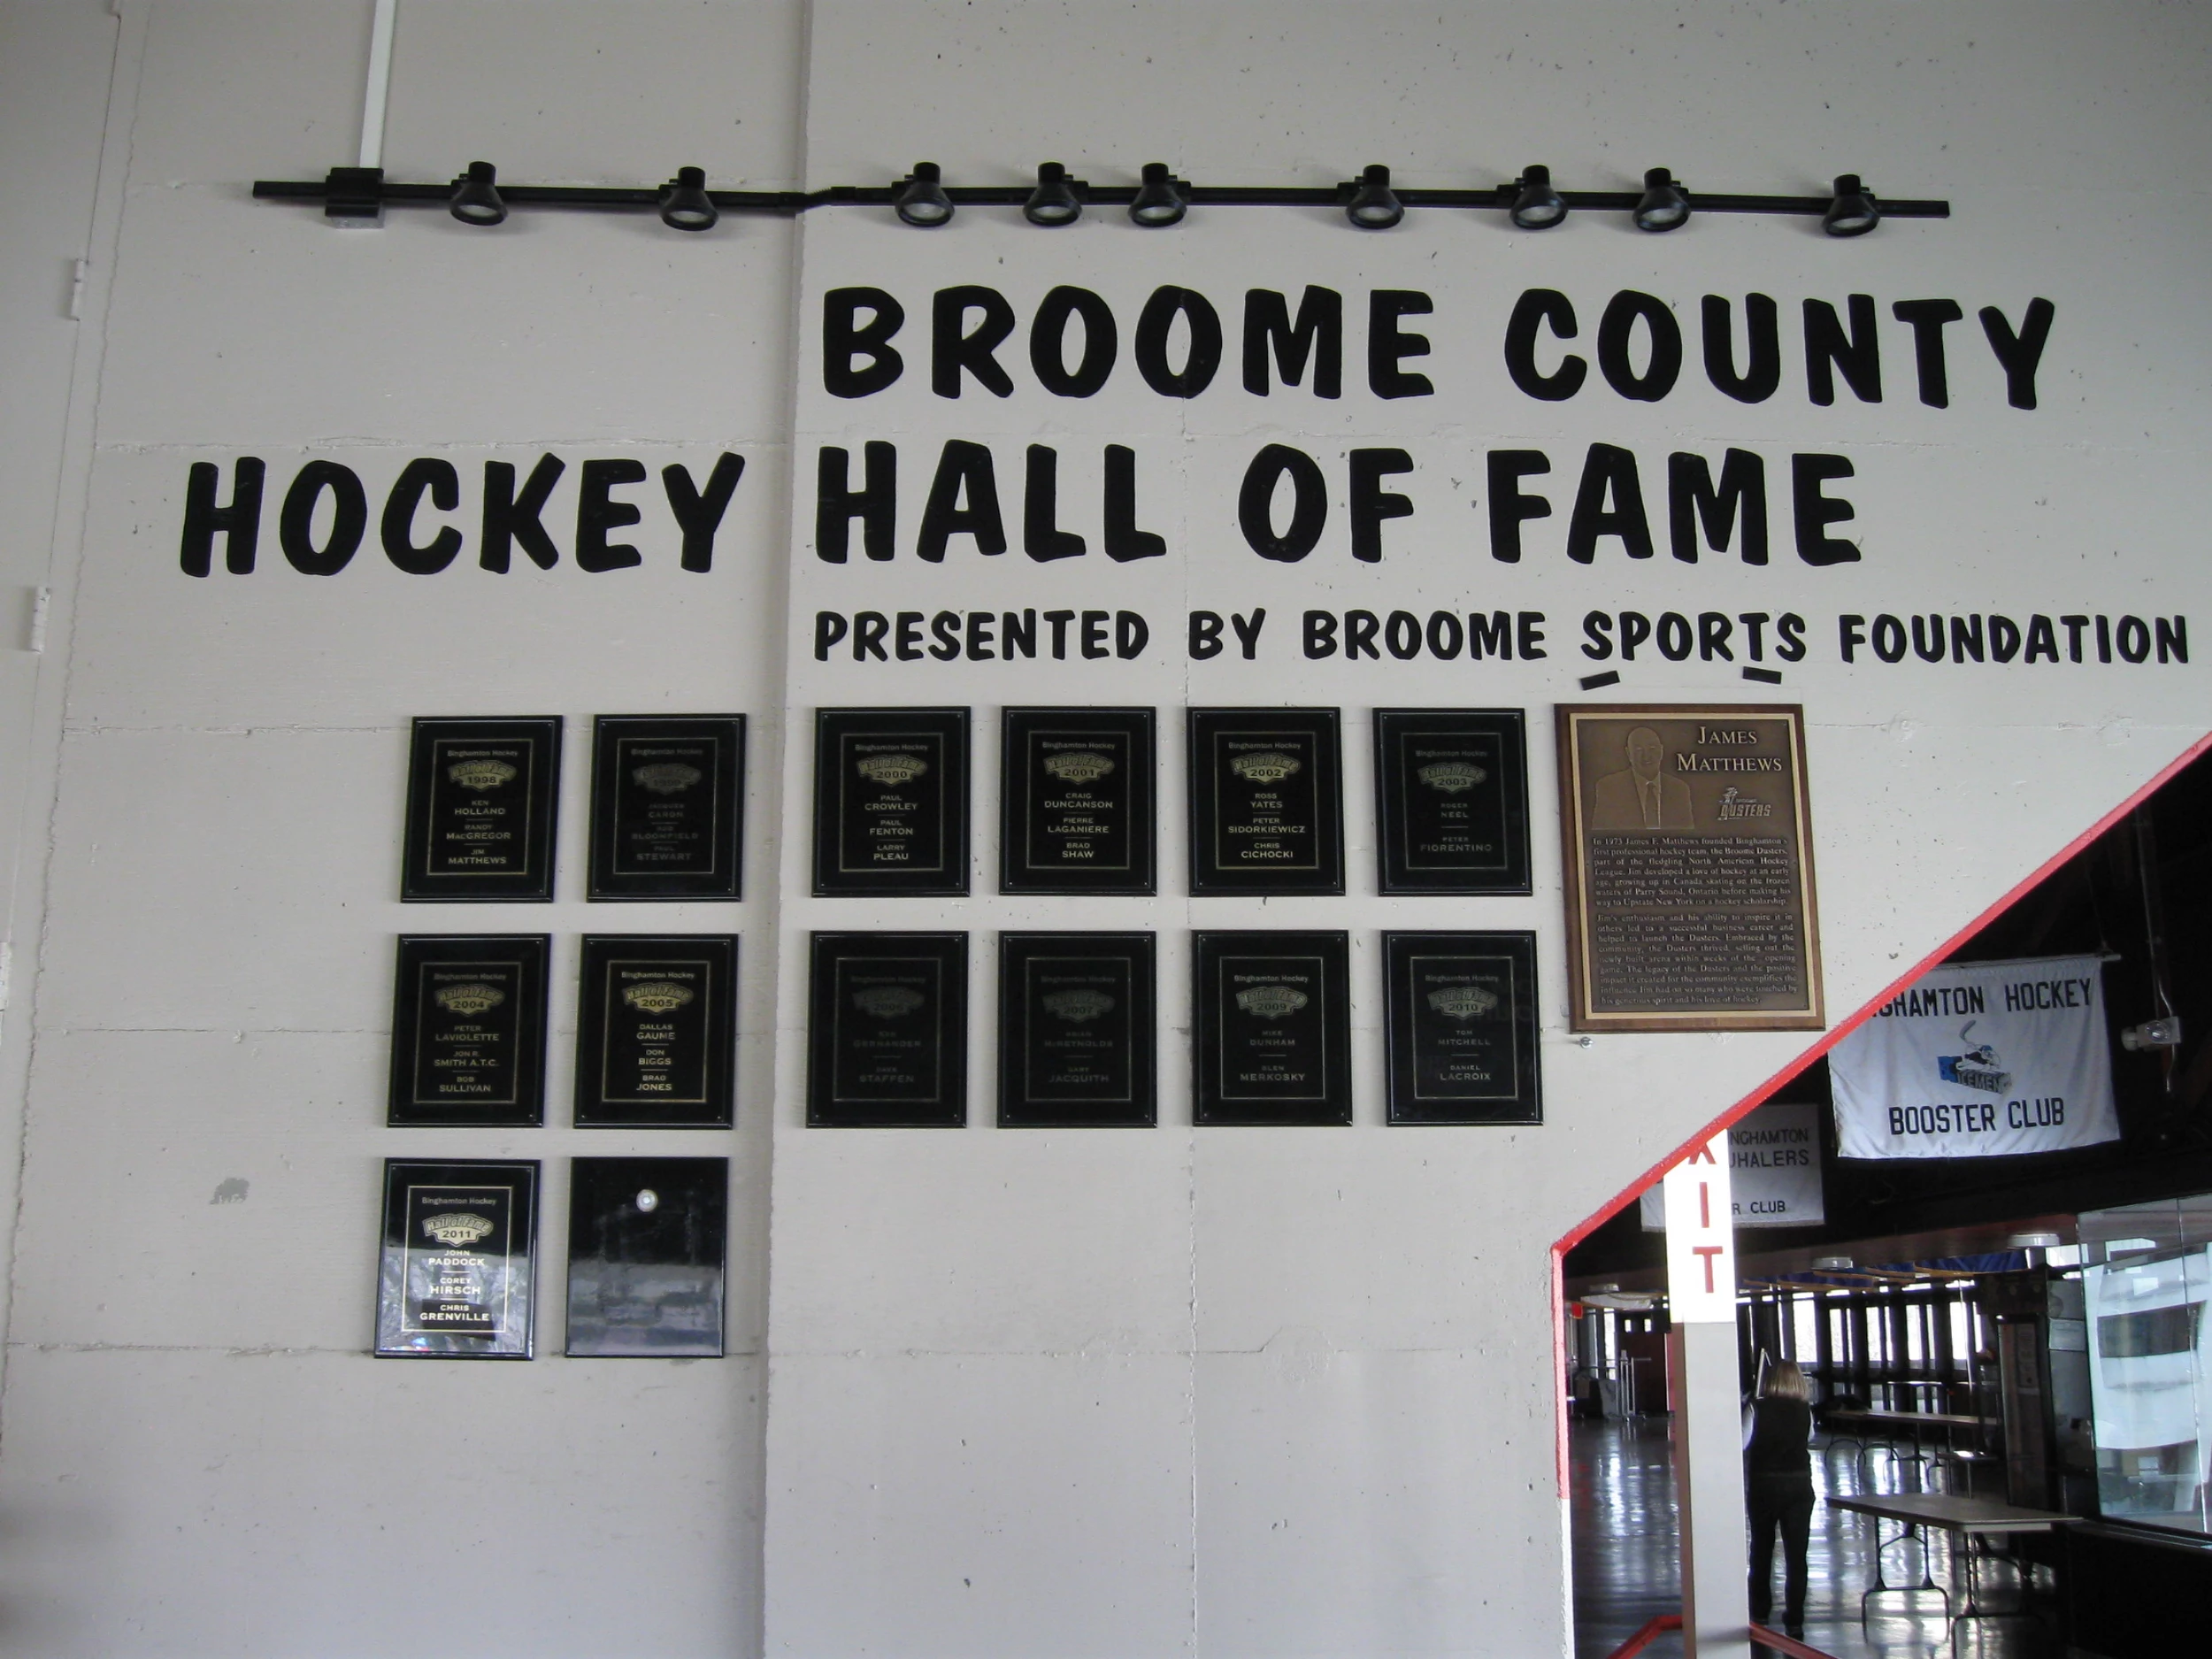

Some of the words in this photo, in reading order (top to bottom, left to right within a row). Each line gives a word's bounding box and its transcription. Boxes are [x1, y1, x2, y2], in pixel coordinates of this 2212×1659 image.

[823, 285, 1434, 399] BROOME
[1505, 288, 2055, 410] COUNTY
[180, 452, 745, 578] HOCKEY
[816, 440, 1166, 564] HALL
[1239, 444, 1413, 563] OF
[1487, 442, 1861, 566] FAME
[815, 609, 1148, 661] PRESENTED
[1189, 608, 1265, 660] BY
[1303, 610, 1547, 660] BROOME
[1581, 611, 1806, 662] SPORTS
[1839, 614, 2188, 664] FOUNDATION
[1698, 726, 1757, 744] JAMES
[1677, 753, 1782, 771] MATTHEWS
[2005, 978, 2091, 1011] HOCKEY
[1889, 1103, 1996, 1134] BOOSTER
[2008, 1097, 2064, 1128] CLUB
[469, 1197, 496, 1206] Hockey
[1750, 1201, 1786, 1214] CLUB
[431, 1286, 480, 1294] HIRSCH
